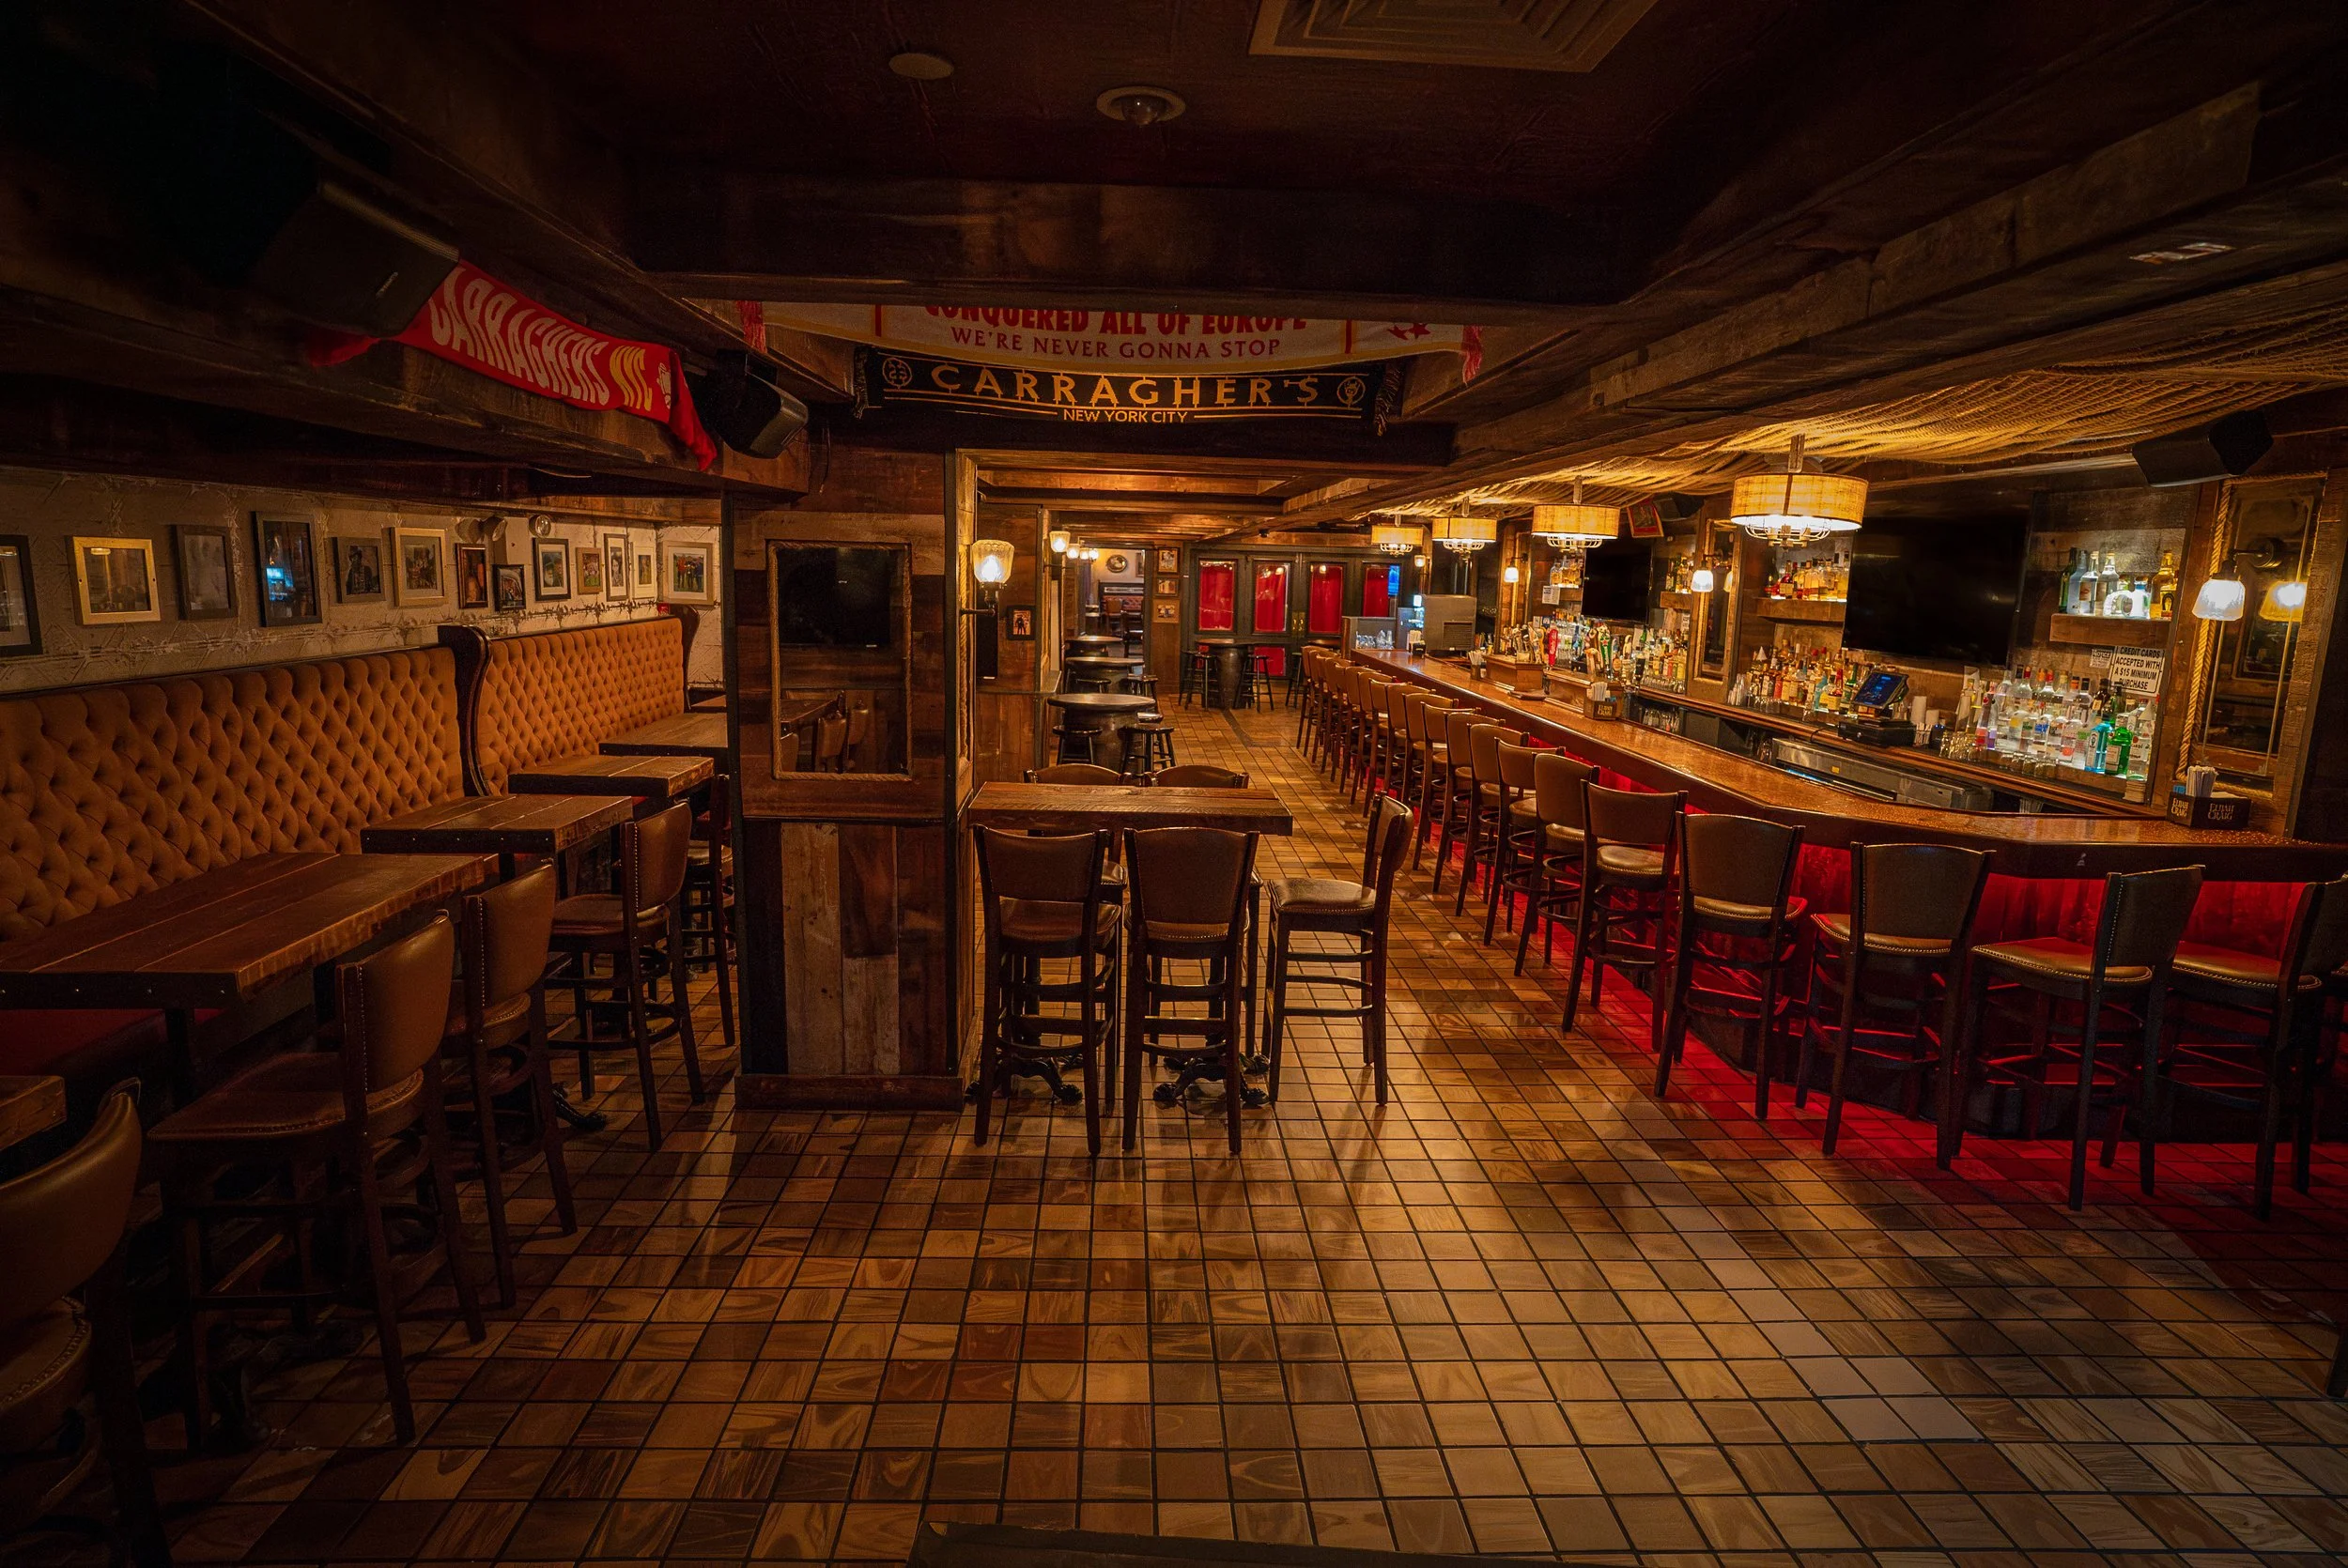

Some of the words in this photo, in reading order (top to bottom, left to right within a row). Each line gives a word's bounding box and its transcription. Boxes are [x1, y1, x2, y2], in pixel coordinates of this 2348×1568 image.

[1099, 308, 1147, 335] ALL
[1157, 312, 1190, 335] OF
[950, 326, 1023, 351] WE'RE
[1033, 336, 1109, 358] NEVER
[1119, 341, 1211, 360] GONNA
[1221, 338, 1280, 357] STOP
[610, 345, 653, 411] NYC
[930, 364, 1319, 407] CARRAGHER'S
[1063, 408, 1101, 423] NEW
[1104, 410, 1148, 423] YORK
[1151, 411, 1188, 423] CITY
[2120, 646, 2141, 656] CREDIT
[2141, 649, 2160, 659] CARDS
[2115, 656, 2144, 668] ACCEPTED
[2145, 659, 2161, 670] WITH
[2114, 667, 2119, 675] A
[2120, 668, 2130, 676] $15
[2130, 669, 2157, 680] MINIMUM
[2119, 678, 2149, 690] PURCHASE
